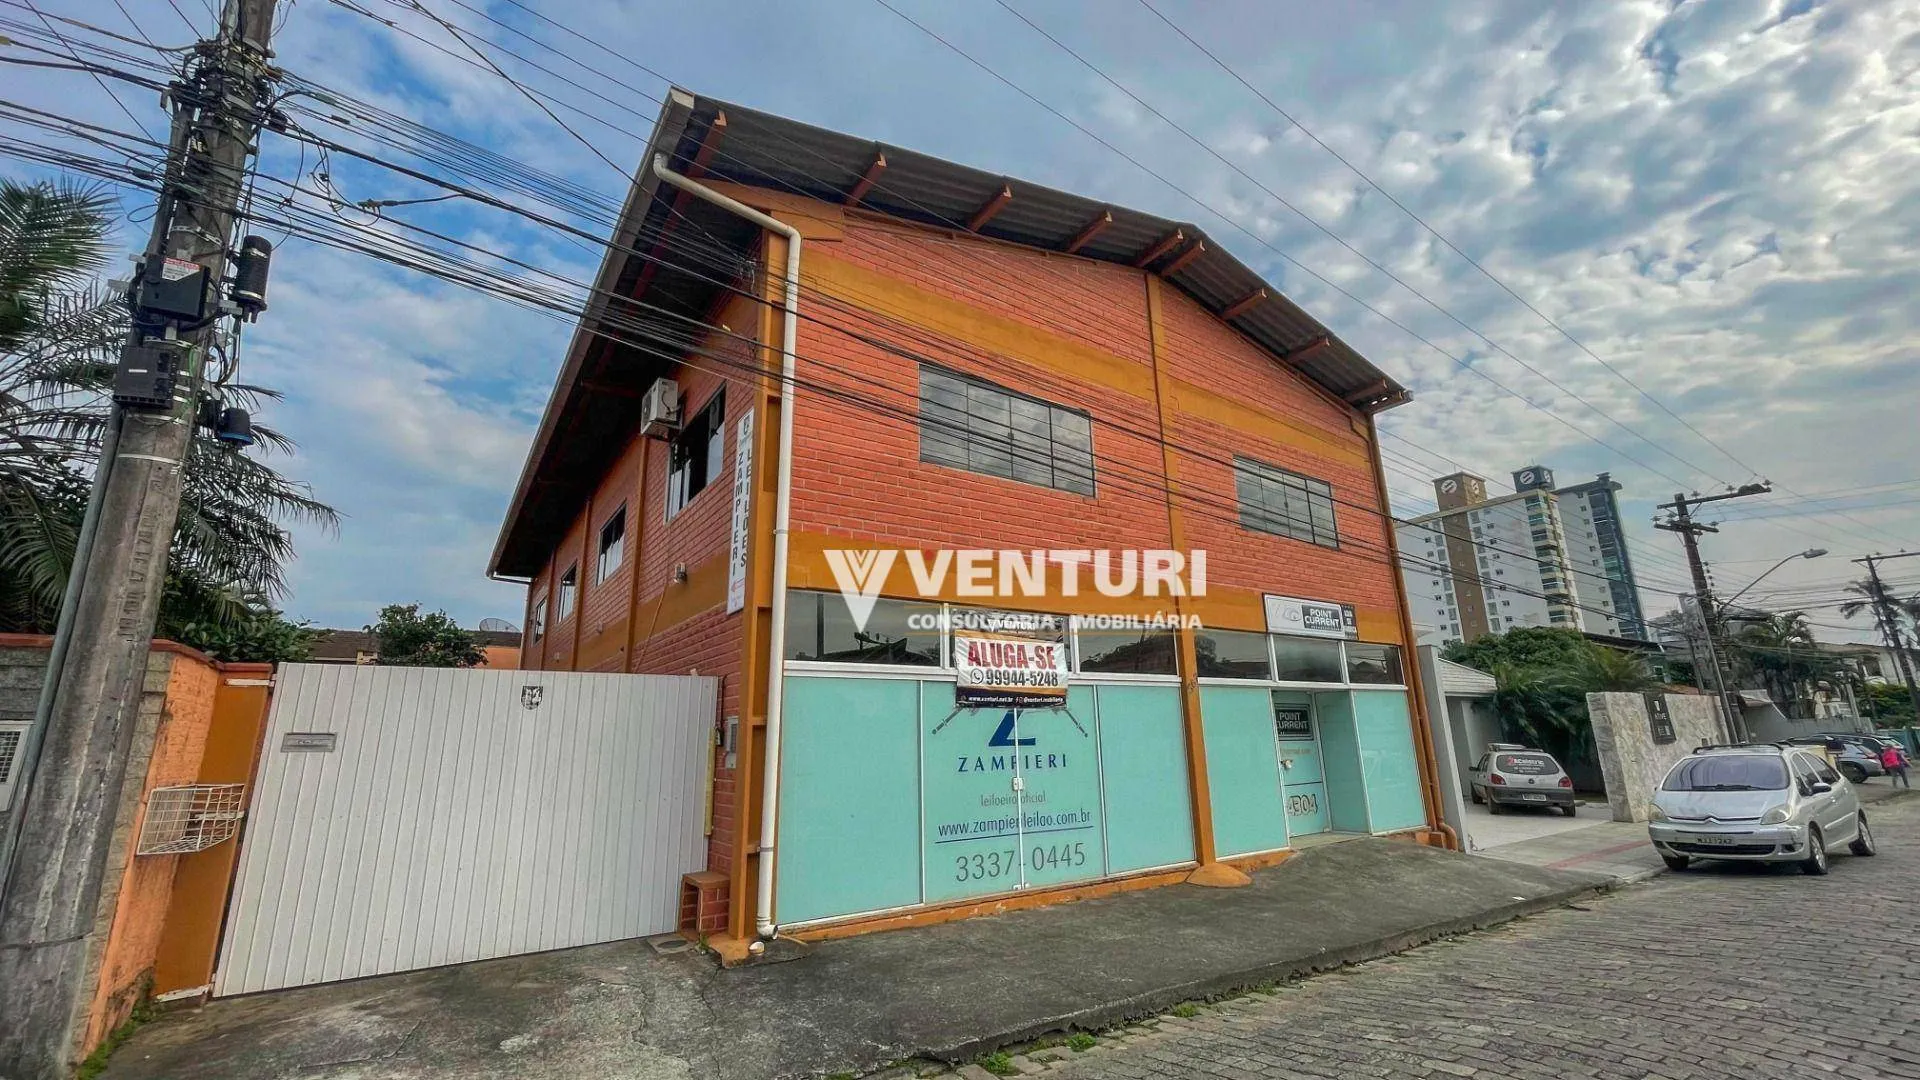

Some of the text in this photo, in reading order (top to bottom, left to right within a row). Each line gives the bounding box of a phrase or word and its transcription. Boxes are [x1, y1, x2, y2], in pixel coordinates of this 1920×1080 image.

[732, 452, 743, 577] ZAMPIERI
[1304, 615, 1340, 628] CURRENT
[1309, 608, 1332, 618] POINT
[967, 641, 1057, 669] ALUGA-SE
[986, 668, 1059, 686] 99944-5248
[1279, 712, 1301, 720] POINT
[958, 753, 1067, 772] ZAMPIERI
